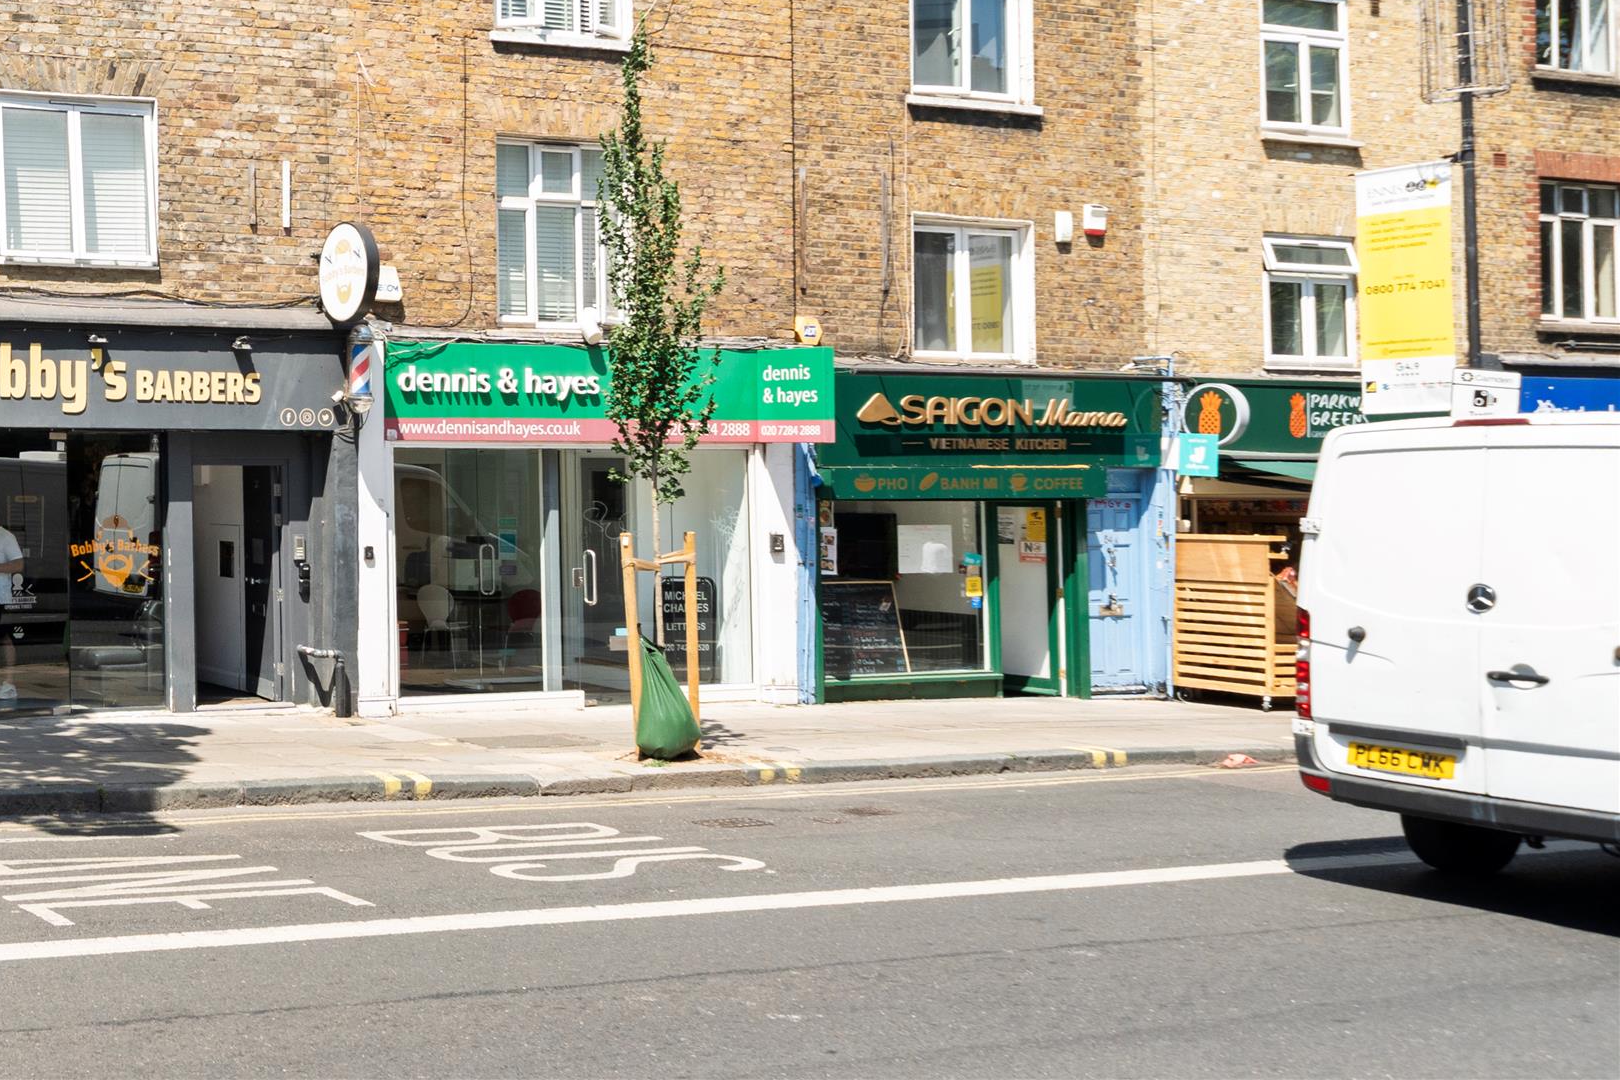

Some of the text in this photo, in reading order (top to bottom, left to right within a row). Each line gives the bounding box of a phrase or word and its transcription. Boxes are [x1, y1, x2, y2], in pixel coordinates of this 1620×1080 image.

[1365, 279, 1447, 296] 0800 774 7041
[762, 364, 811, 382] dennis
[136, 369, 262, 404] BARBERS
[397, 365, 600, 402] dennis & hayes
[762, 387, 818, 407] & hayes
[1310, 393, 1362, 410] PARKW
[900, 394, 1034, 428] SAIGON
[1035, 397, 1129, 428] Mama
[399, 420, 751, 439] www.dennisandhayes.co.uk 20 74 2888
[761, 424, 821, 437] 020 7284 2888
[929, 437, 1068, 451] VIETNAMESE KITCHEN
[878, 477, 1083, 490] PHO BANH MI COFFEE
[70, 538, 160, 558] Bobby's Barbers
[664, 591, 707, 601] MICHEL
[663, 603, 709, 613] CHAES
[666, 622, 706, 631] LETTGS
[1355, 745, 1400, 767] PL66
